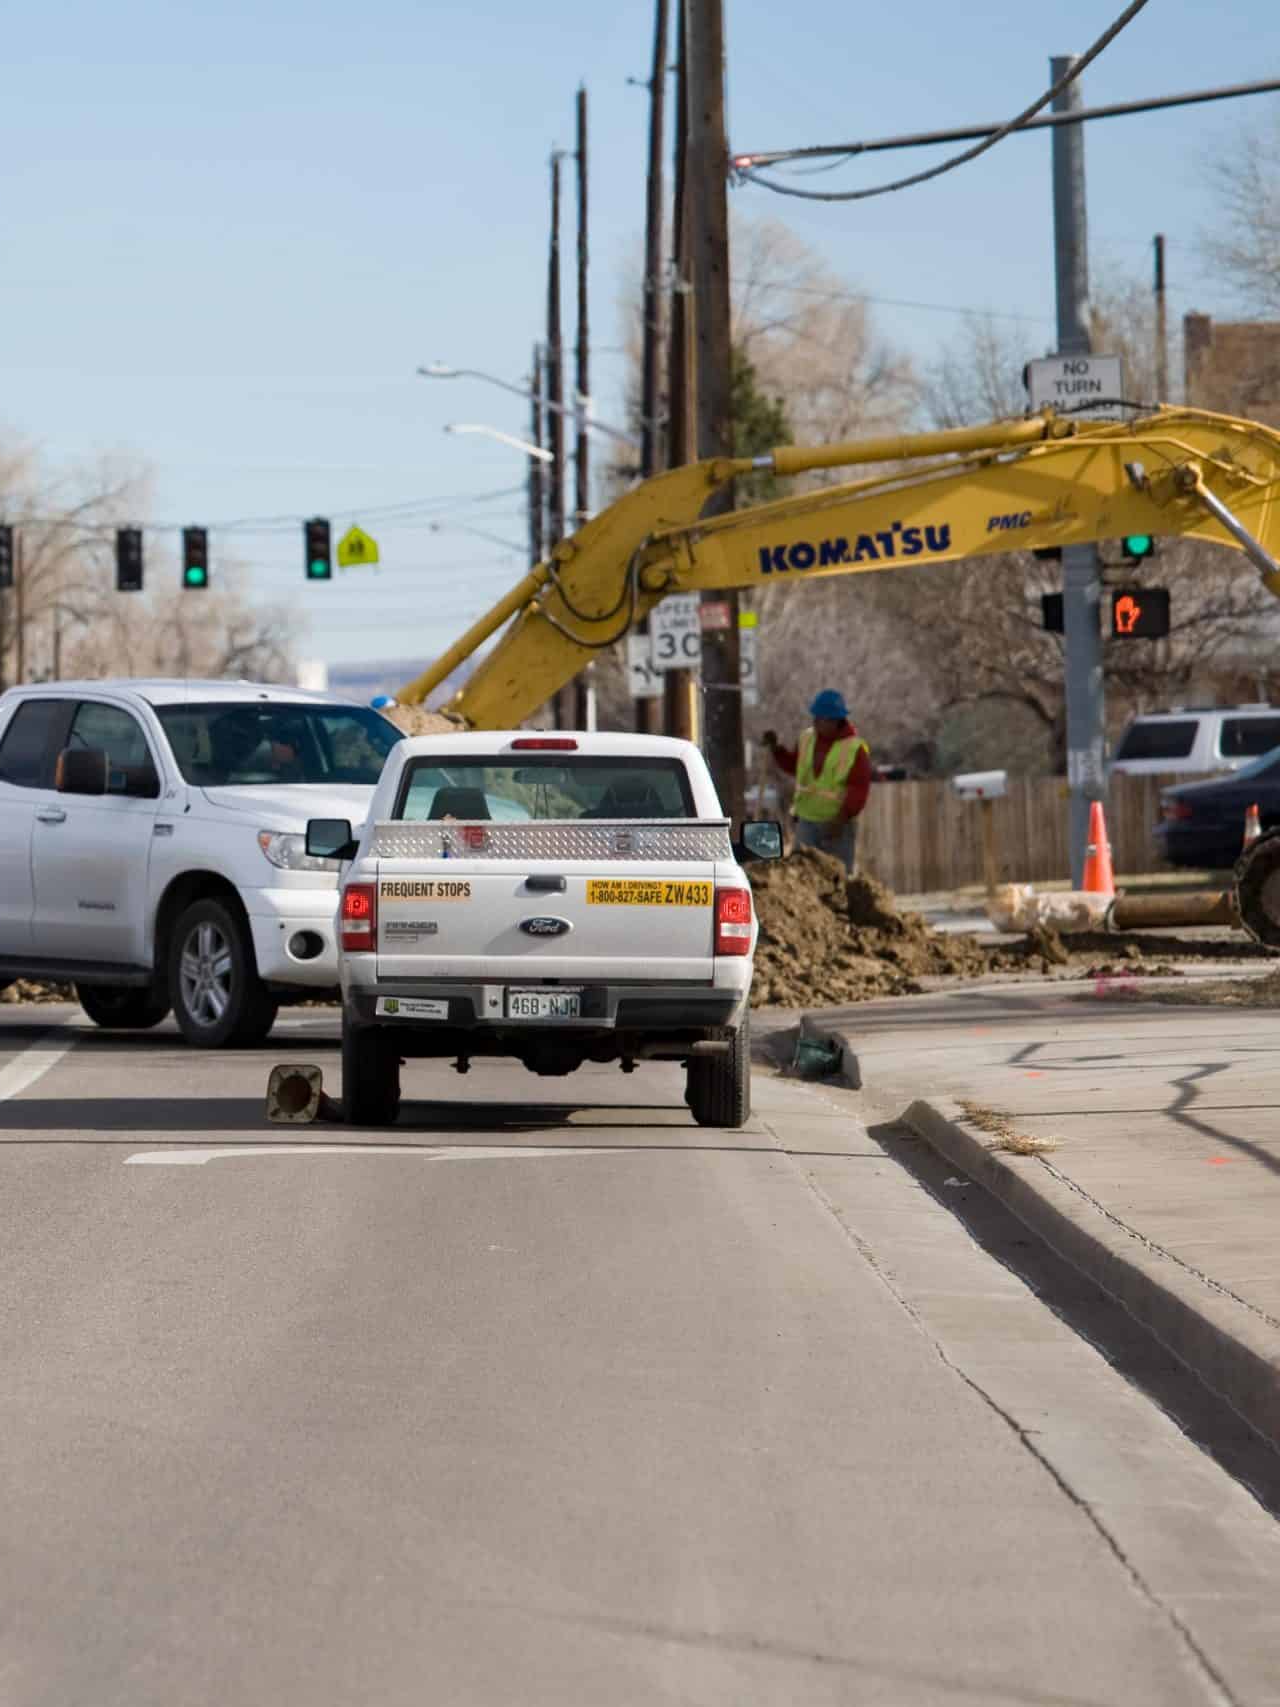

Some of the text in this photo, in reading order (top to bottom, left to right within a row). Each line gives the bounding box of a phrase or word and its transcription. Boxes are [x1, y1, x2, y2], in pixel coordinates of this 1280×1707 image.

[1063, 360, 1089, 375] NO
[1055, 379, 1102, 394] TURN
[759, 511, 1032, 573] KOMATSU PMC
[657, 632, 700, 659] 30
[380, 882, 471, 898] FREQUENT STOPS
